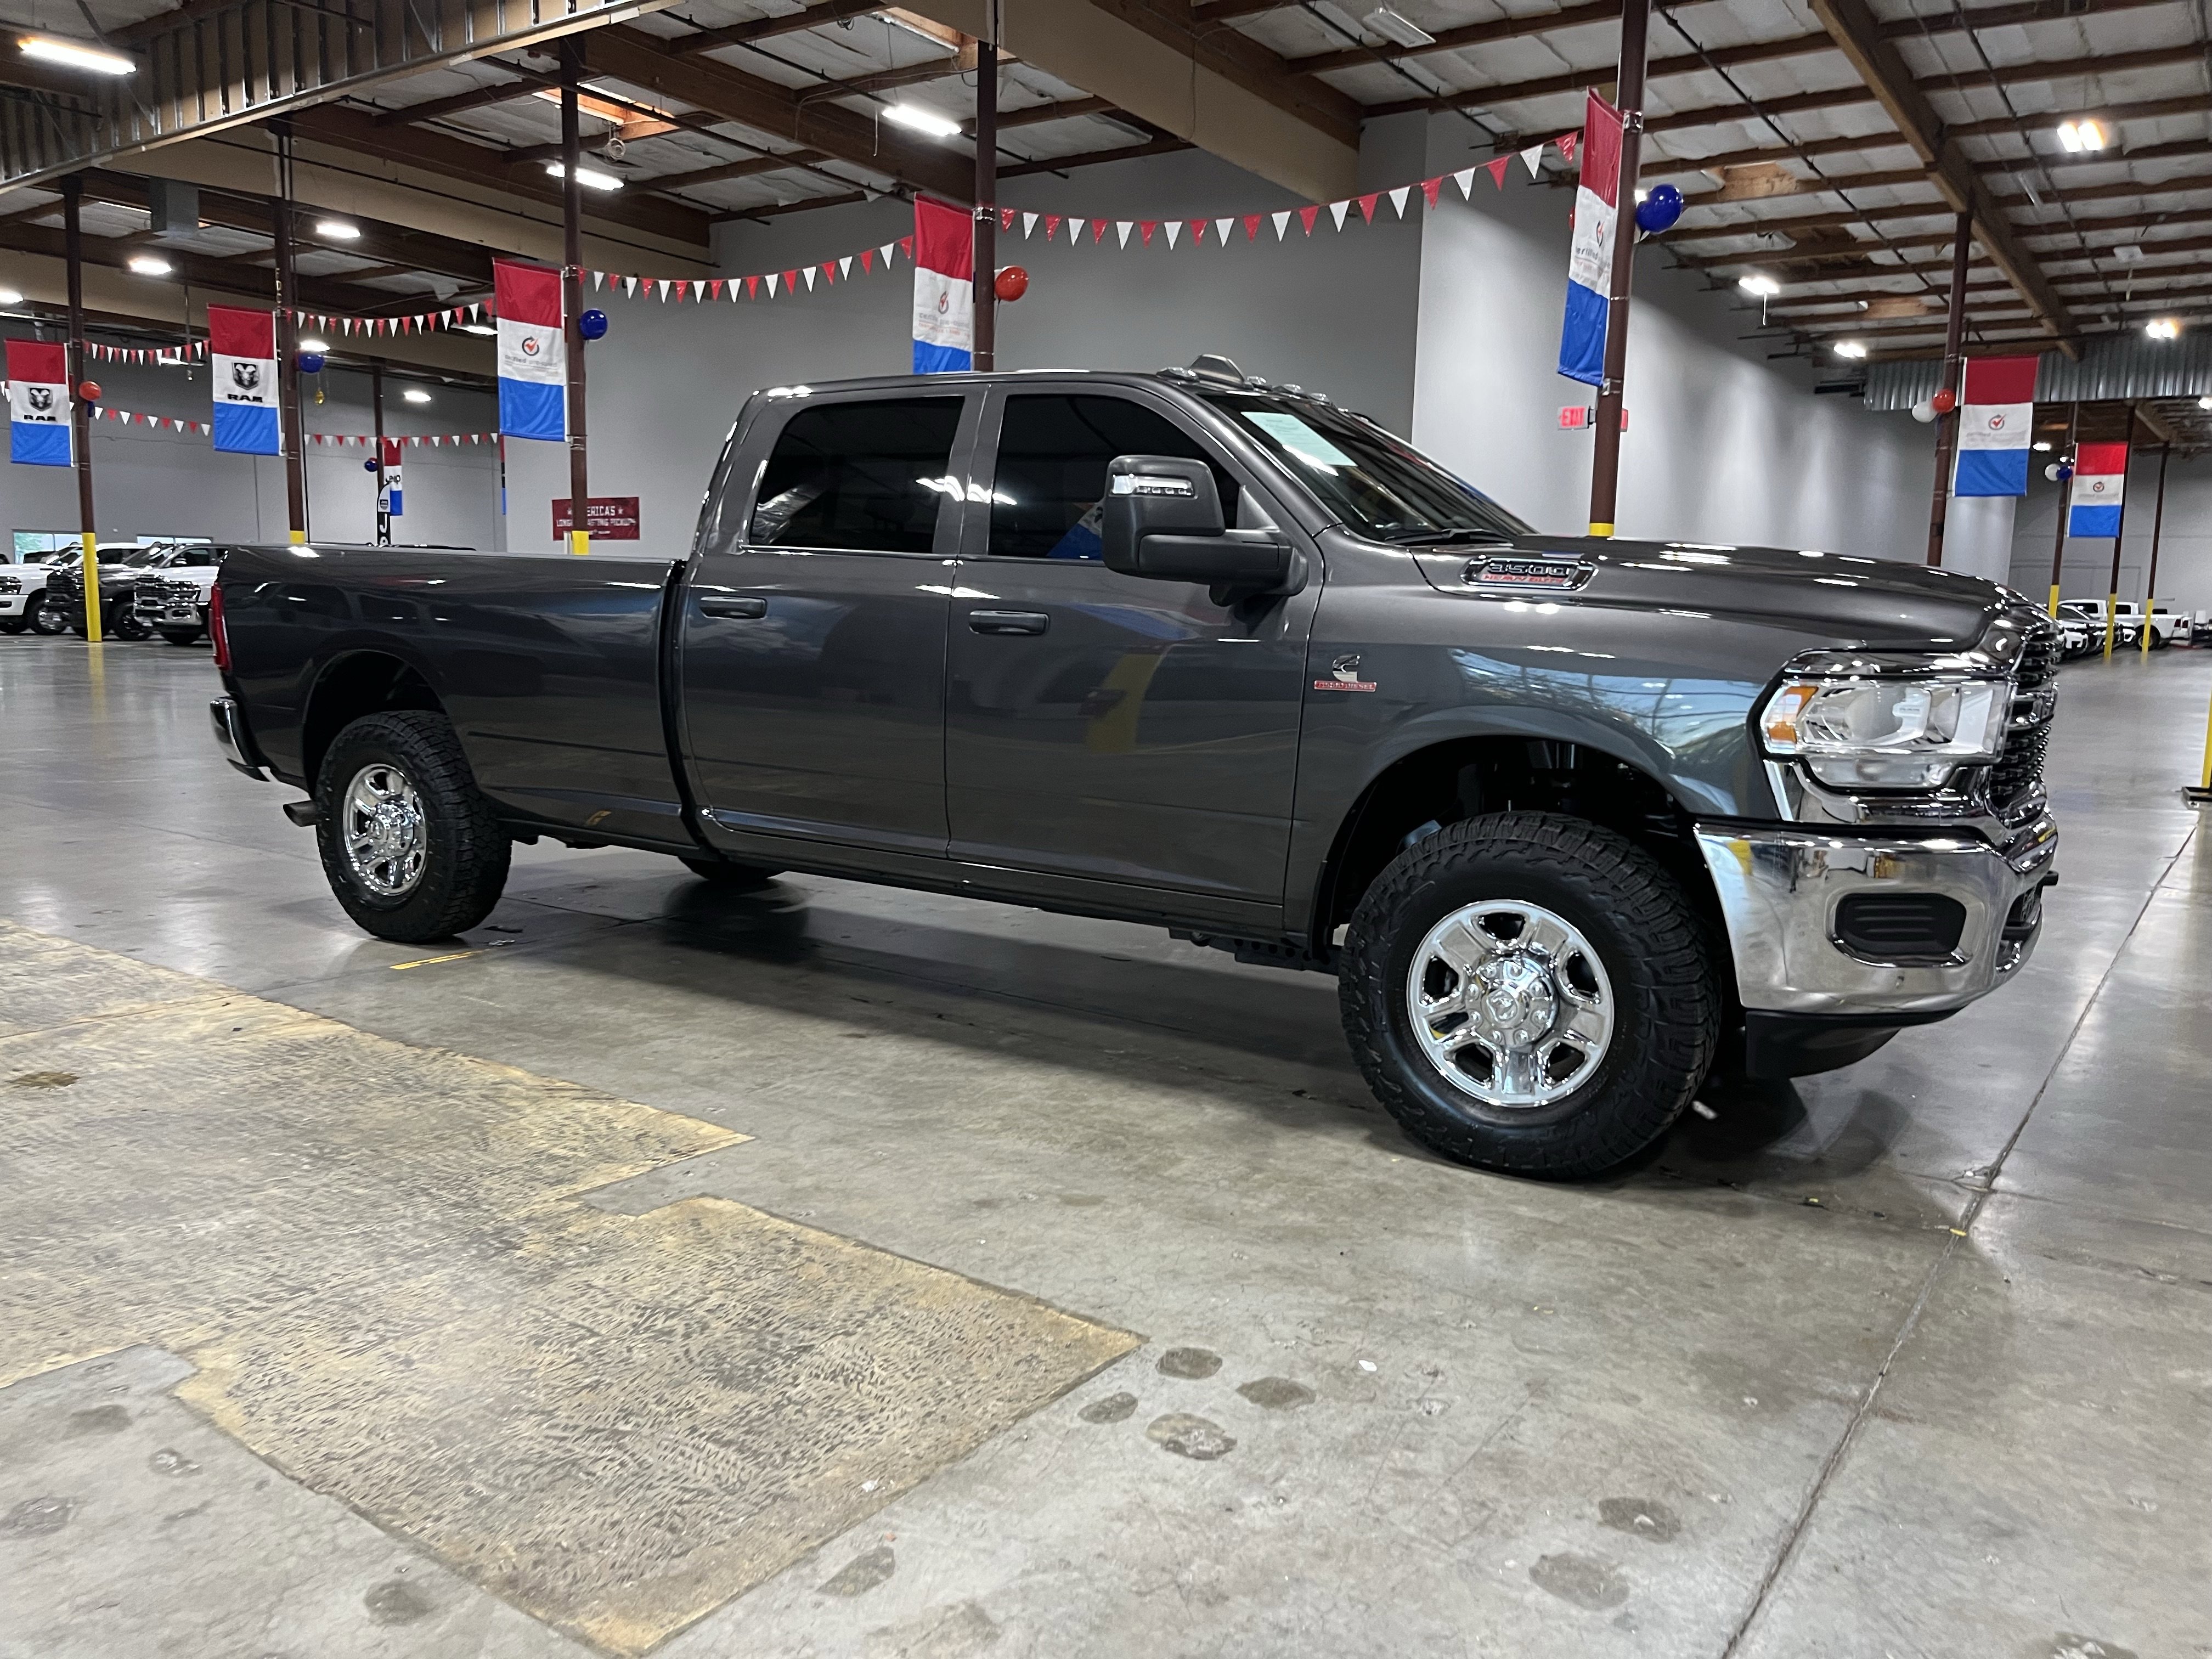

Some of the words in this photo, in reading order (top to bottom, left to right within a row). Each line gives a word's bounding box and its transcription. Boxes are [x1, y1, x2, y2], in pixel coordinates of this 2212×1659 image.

[227, 393, 263, 403] RAM
[1562, 408, 1585, 427] EXIT
[1489, 563, 1570, 575] 3500
